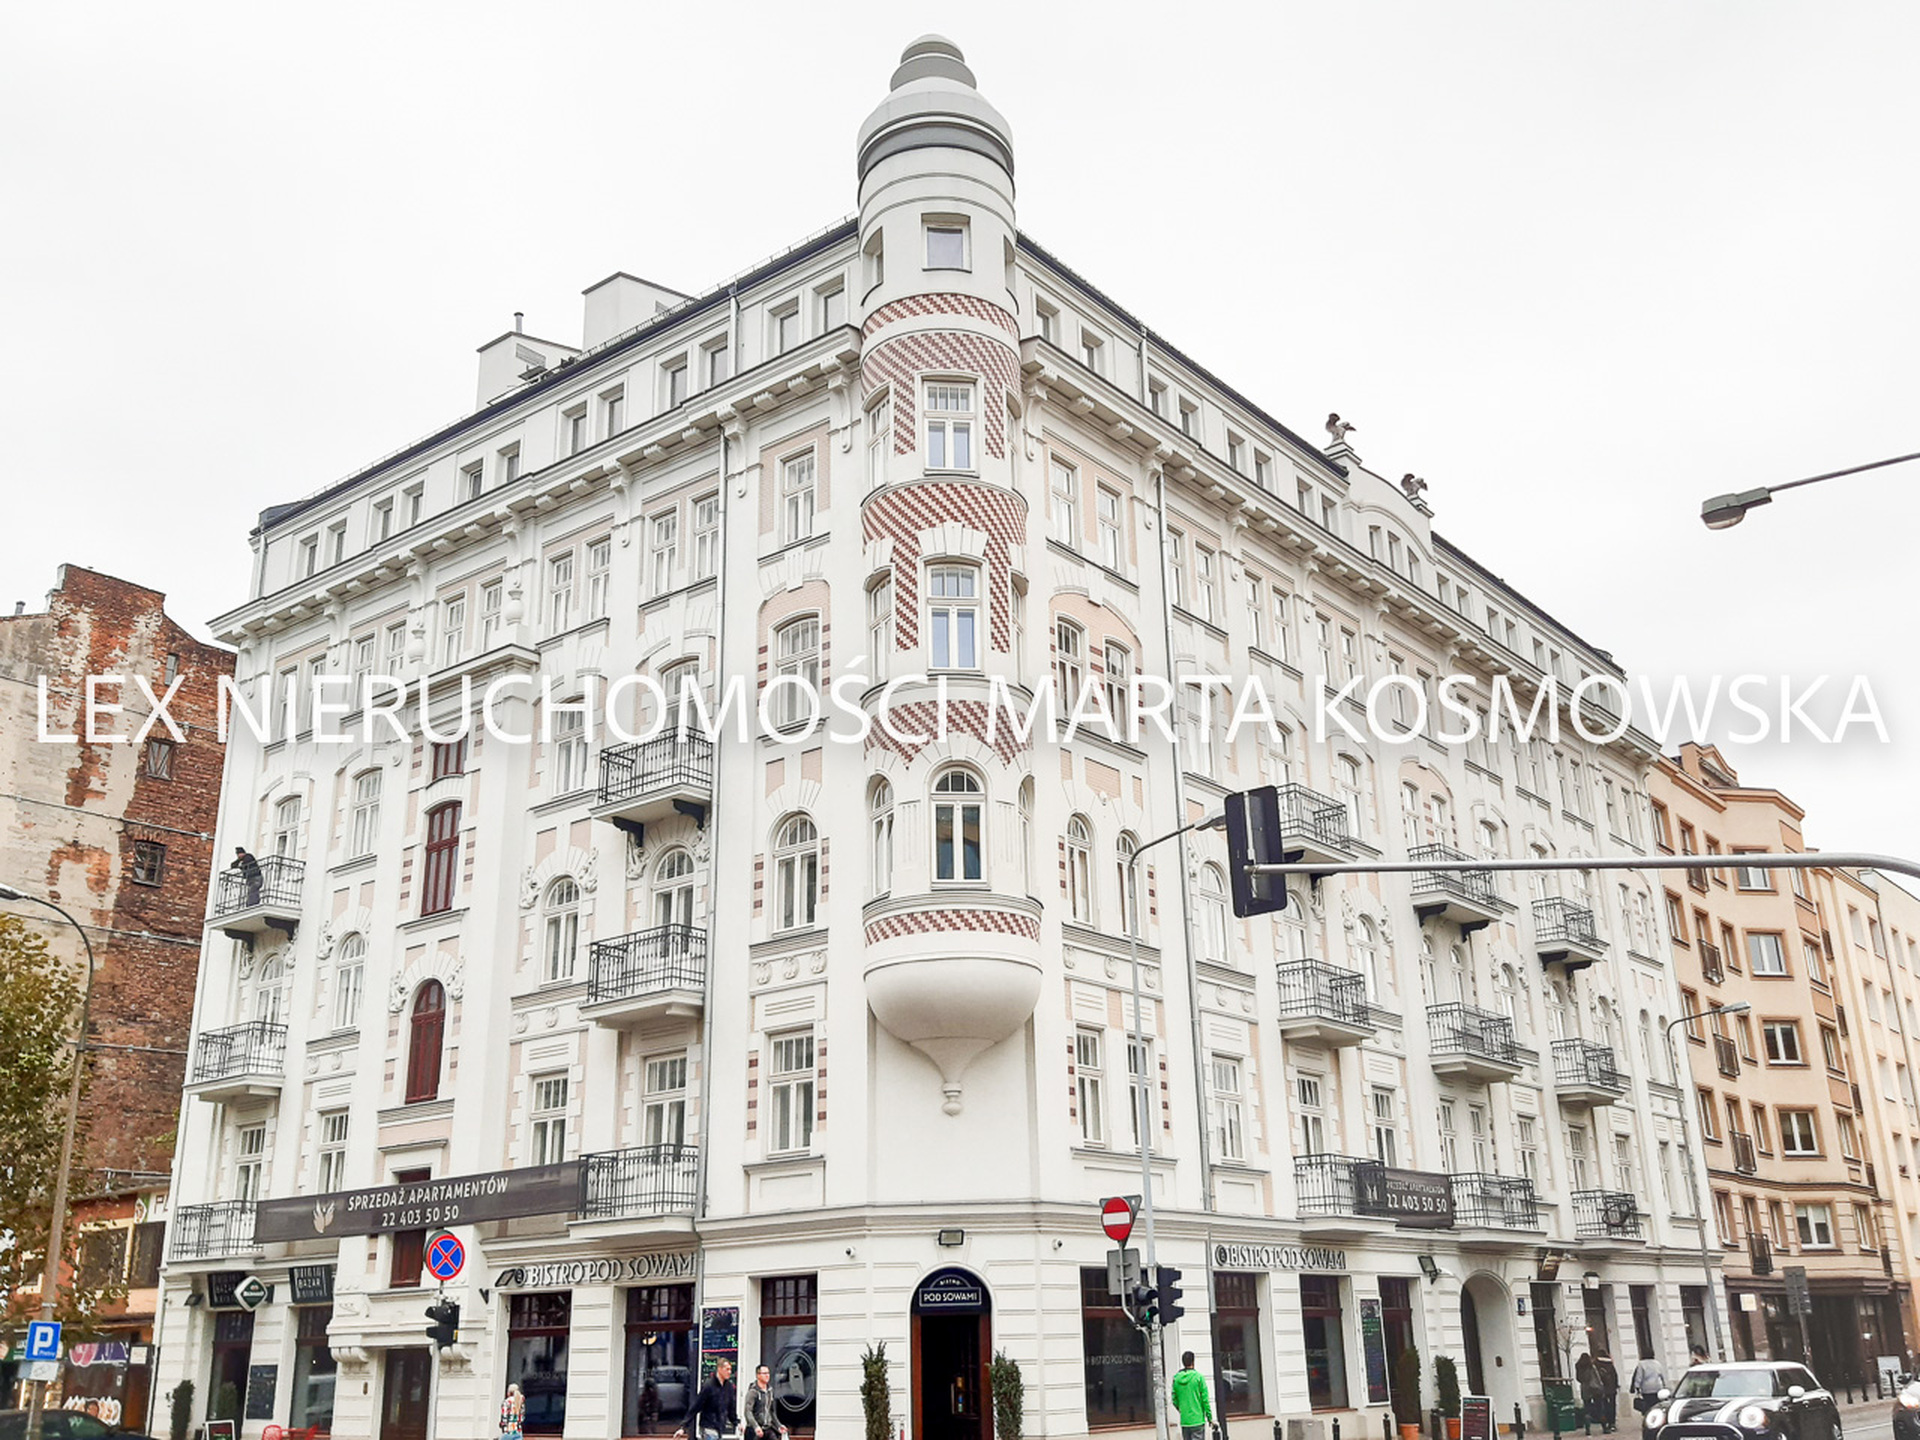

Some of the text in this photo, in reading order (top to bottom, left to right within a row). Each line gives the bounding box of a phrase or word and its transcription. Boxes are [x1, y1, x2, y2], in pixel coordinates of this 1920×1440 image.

[347, 1176, 509, 1211] SPRZEDAŻ APARTAMENTÓW
[1386, 1192, 1447, 1212] 22 403 50 50
[382, 1205, 459, 1227] 22 403 50 50
[1229, 1244, 1346, 1270] BISTRO POD SOWAMI
[525, 1261, 586, 1287] BISTRO
[588, 1258, 623, 1281] POD
[939, 1278, 961, 1286] BISTRO
[923, 1291, 978, 1302] POD SOWAMI
[33, 1326, 54, 1356] P
